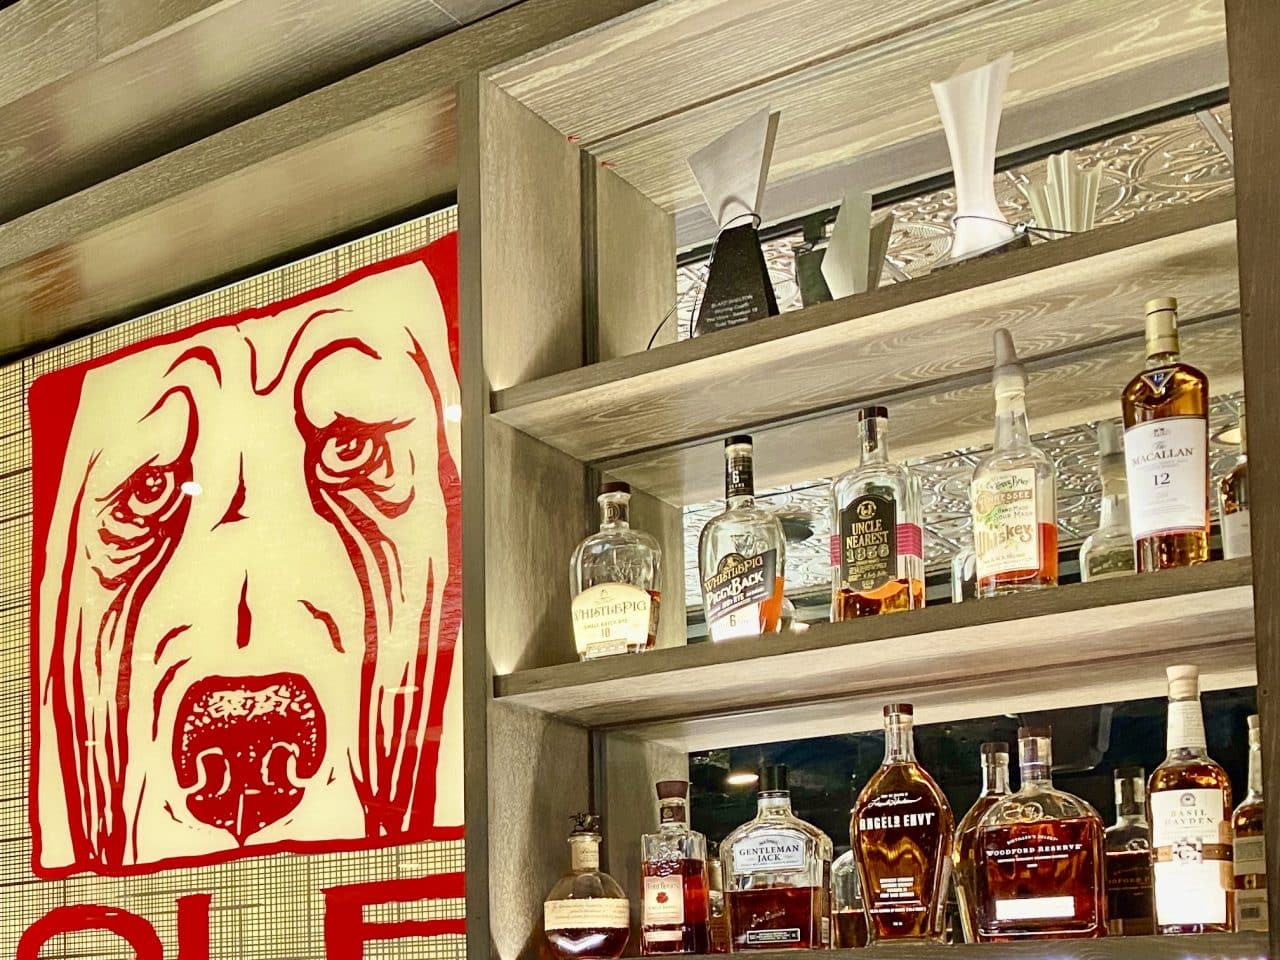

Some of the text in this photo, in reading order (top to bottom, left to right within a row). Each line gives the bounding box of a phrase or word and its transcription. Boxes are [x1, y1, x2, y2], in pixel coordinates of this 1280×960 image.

[1133, 448, 1193, 465] MACALLAN
[732, 470, 740, 484] 6
[1154, 472, 1170, 486] 12
[851, 519, 882, 535] UNCLE
[846, 531, 889, 549] NEAREST
[729, 615, 736, 627] 6
[903, 813, 932, 827] ENVY
[740, 845, 799, 856] GENTLEMAN
[986, 844, 1082, 857] WOODFORD RESERVE
[758, 854, 781, 863] JACK
